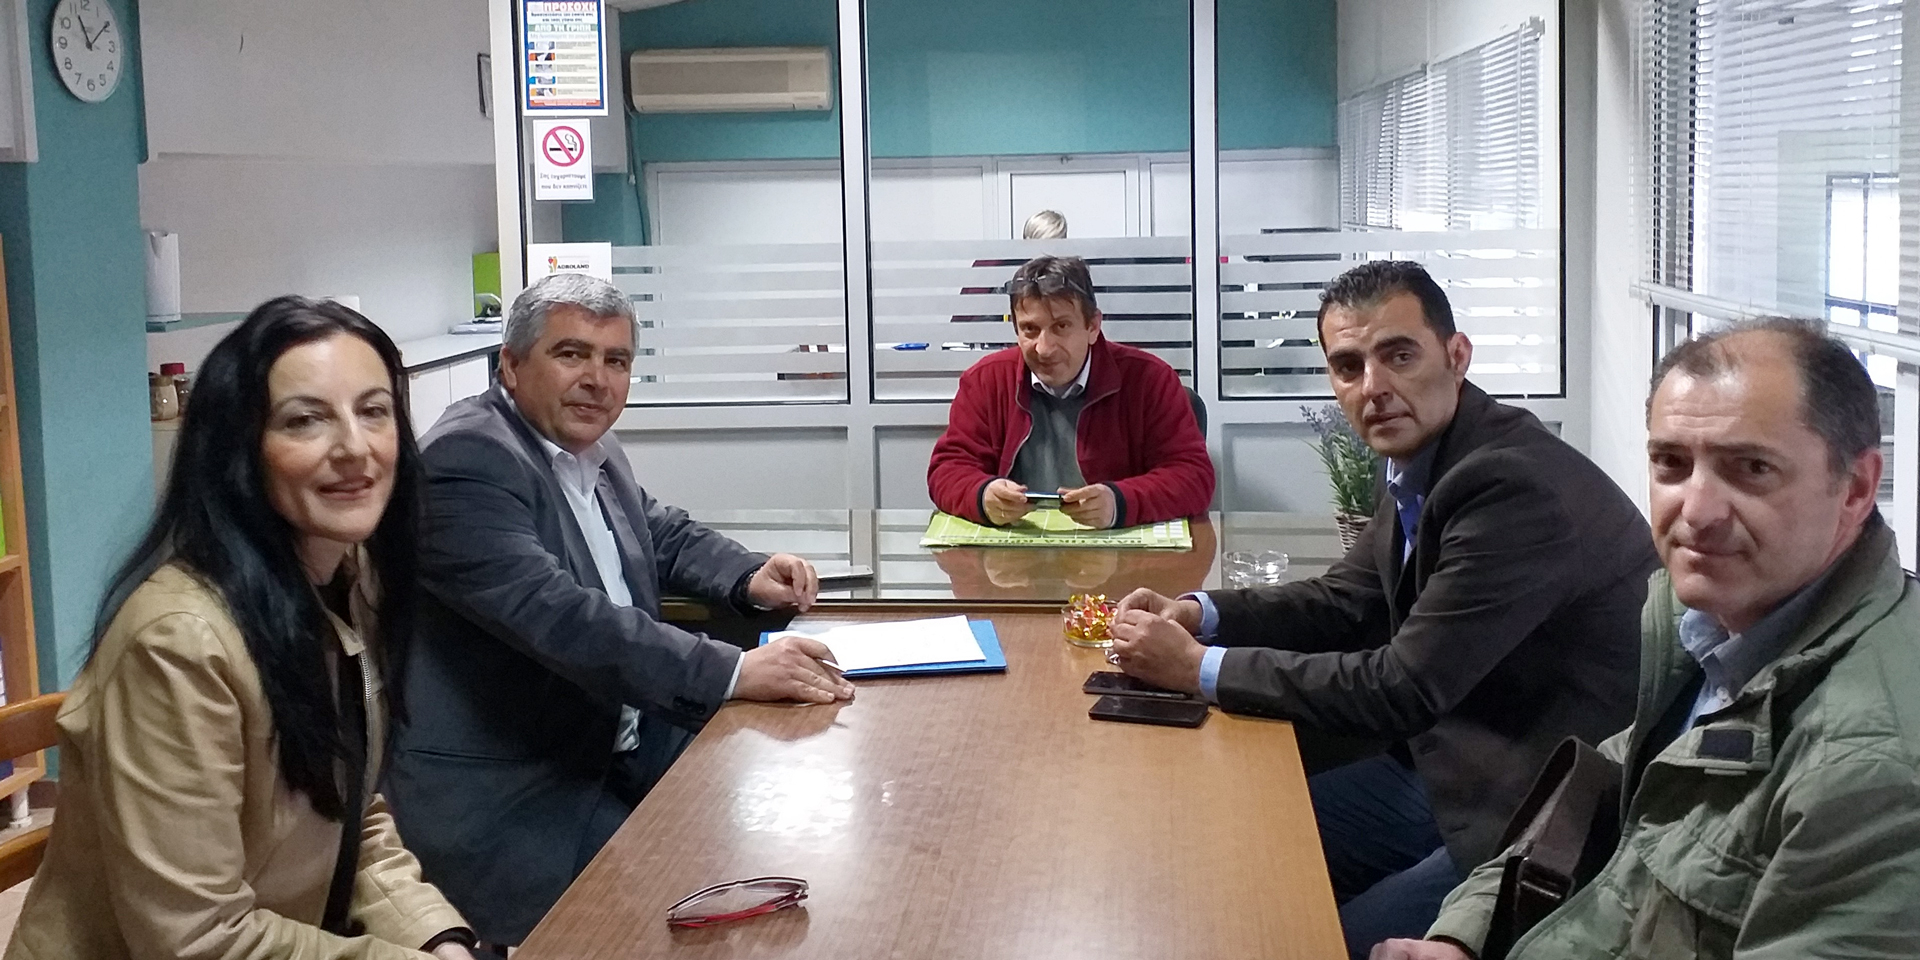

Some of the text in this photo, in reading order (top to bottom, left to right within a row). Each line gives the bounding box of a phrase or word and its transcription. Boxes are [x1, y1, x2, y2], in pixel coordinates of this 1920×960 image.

[69, 2, 77, 15] 11
[80, 0, 90, 11] 12
[543, 1, 597, 12] ΠΡΟΣΟΧΗ
[60, 17, 71, 30] 10
[58, 36, 67, 49] 9
[108, 41, 115, 53] 3
[64, 57, 72, 70] 8
[106, 60, 114, 72] 4
[75, 72, 81, 85] 7
[87, 79, 95, 91] 6
[99, 74, 106, 87] 5
